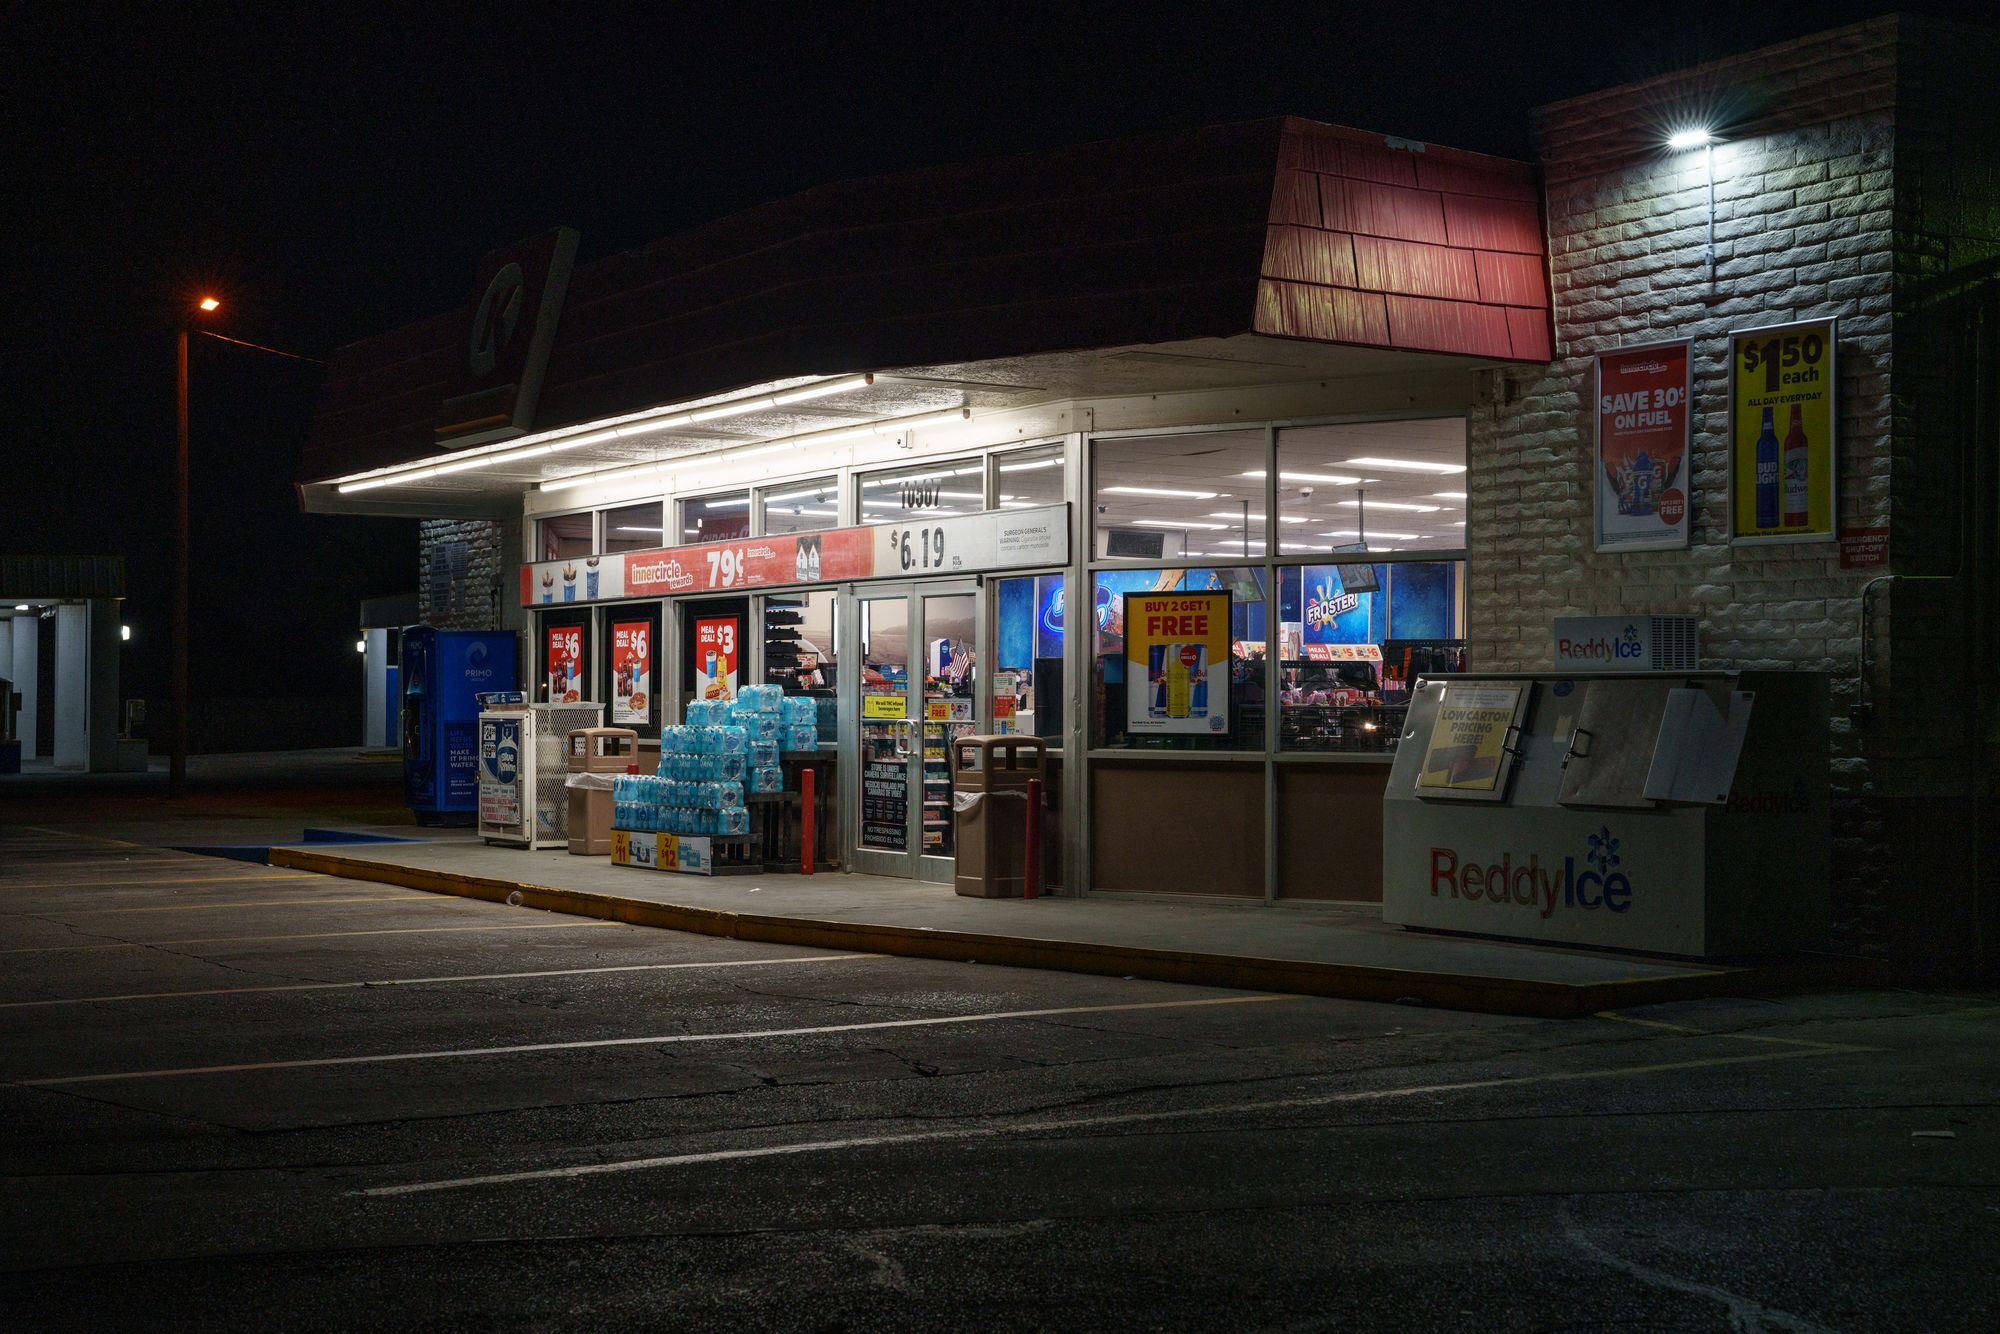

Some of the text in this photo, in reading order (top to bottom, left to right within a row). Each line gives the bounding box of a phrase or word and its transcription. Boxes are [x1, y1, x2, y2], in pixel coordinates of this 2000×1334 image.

[1782, 366, 1819, 385] each
[1602, 391, 1649, 414] SAVE
[1747, 391, 1823, 407] ALL DAY EVERYDAY
[1615, 410, 1672, 429] ON FUEL
[1757, 461, 1778, 473] BUD
[1661, 505, 1682, 515] FREE
[1840, 535, 1889, 544] EMERGENCY
[1845, 544, 1882, 553] SHUT-OFF
[1850, 554, 1880, 562] SWITCH
[631, 560, 682, 585] innercircle
[670, 573, 694, 590] rewards
[1145, 600, 1210, 612] BUY 2 GET 1
[700, 625, 714, 634] MEAL
[1147, 615, 1208, 636] FREE
[552, 633, 564, 641] MEAL
[616, 630, 629, 639] MEAL
[700, 634, 715, 643] DEAL!
[717, 625, 734, 654] $3
[552, 641, 564, 649] DEAL!
[565, 632, 579, 659] $6
[616, 639, 630, 648] DEAL!
[631, 630, 647, 659] $6
[465, 669, 492, 677] PRIMO
[931, 709, 945, 717] FREE
[1441, 710, 1510, 722] LOW CARTON
[1450, 721, 1493, 733] PRICING
[1452, 733, 1484, 745] HERE!
[870, 763, 883, 771] STORE
[886, 764, 899, 772] UNDER
[864, 770, 906, 780] CAMERA SURVEILLANCE
[864, 780, 880, 788] NEGOCIO
[891, 790, 902, 798] VIDEO
[874, 827, 901, 835] TRESPASSING
[892, 836, 904, 845] PASO
[616, 844, 626, 862] $11
[661, 849, 676, 867] $12
